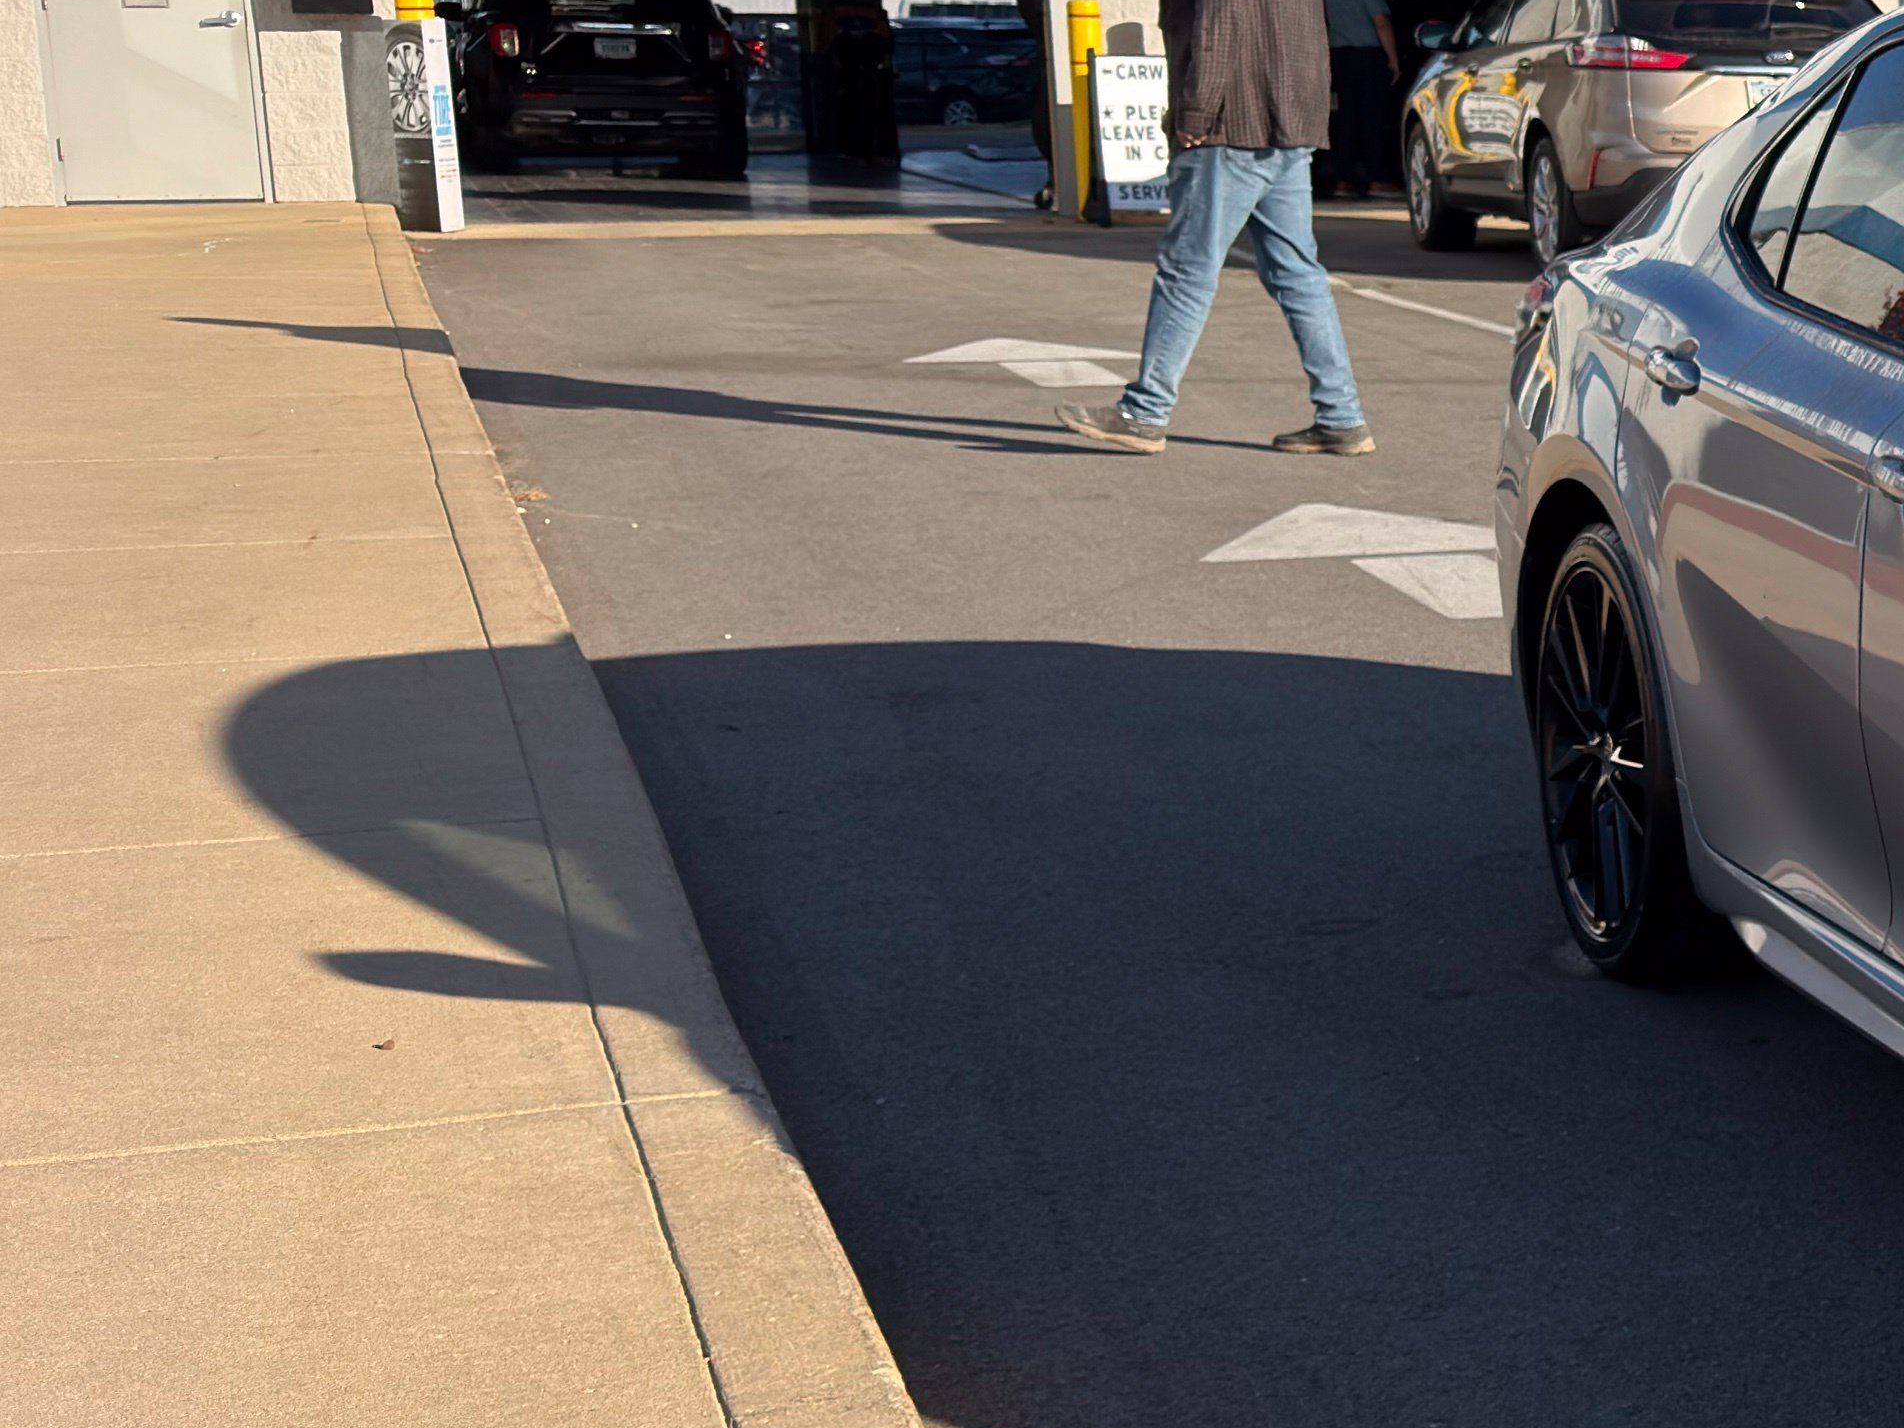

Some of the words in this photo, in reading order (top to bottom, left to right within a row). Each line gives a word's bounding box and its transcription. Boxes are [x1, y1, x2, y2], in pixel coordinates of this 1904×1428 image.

[1116, 63, 1163, 80] CARW
[1102, 125, 1157, 141] LEAVE
[1125, 145, 1142, 161] IN
